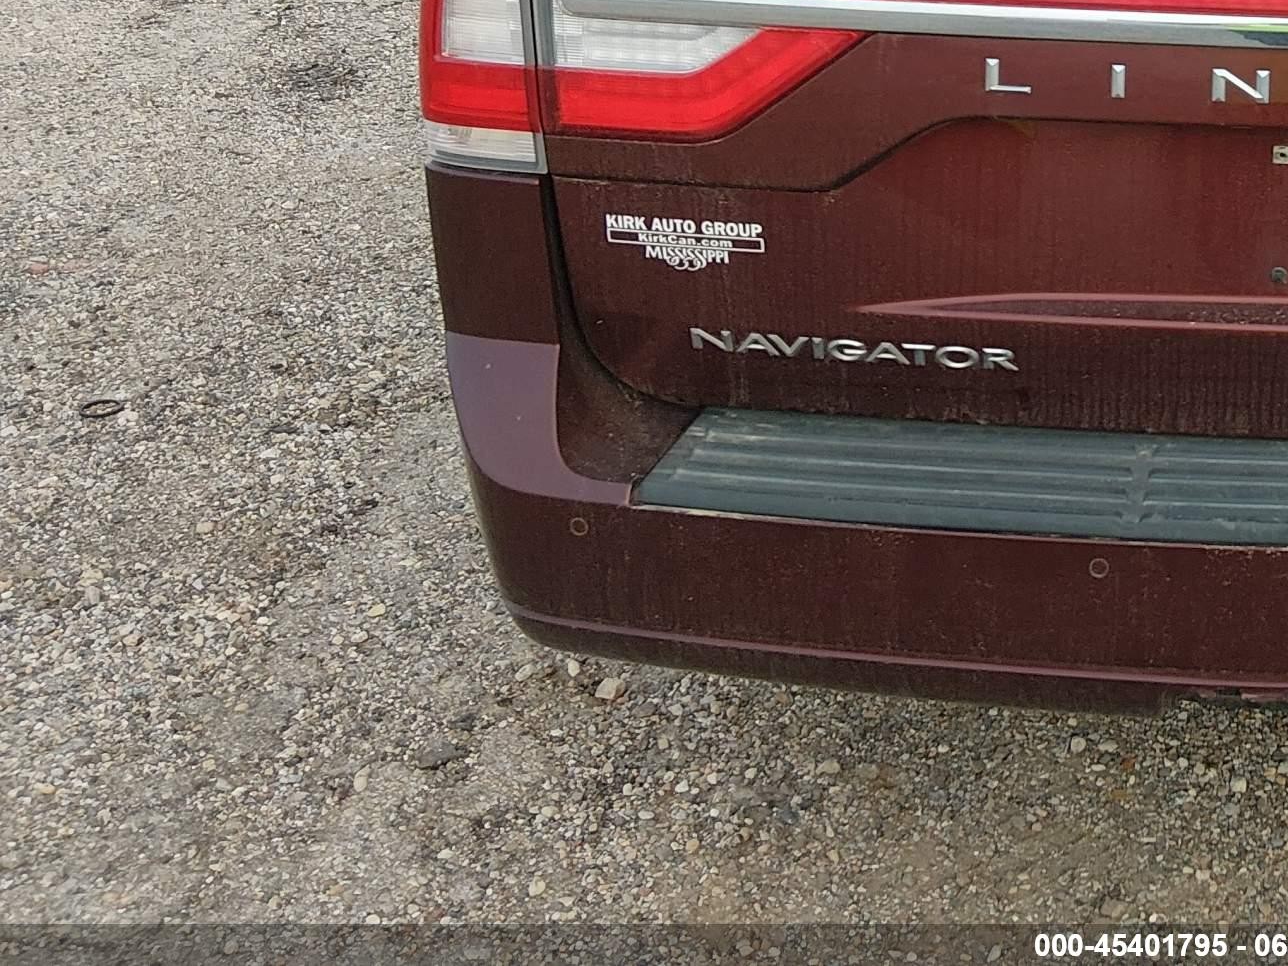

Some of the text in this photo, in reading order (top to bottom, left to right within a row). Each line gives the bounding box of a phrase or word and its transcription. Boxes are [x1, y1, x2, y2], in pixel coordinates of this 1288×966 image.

[605, 214, 762, 237] KIRK AUTO GROUP
[638, 233, 733, 248] KirkCan.com
[645, 246, 730, 271] MISSISSIPPI
[689, 327, 1020, 372] NAVIGATOR
